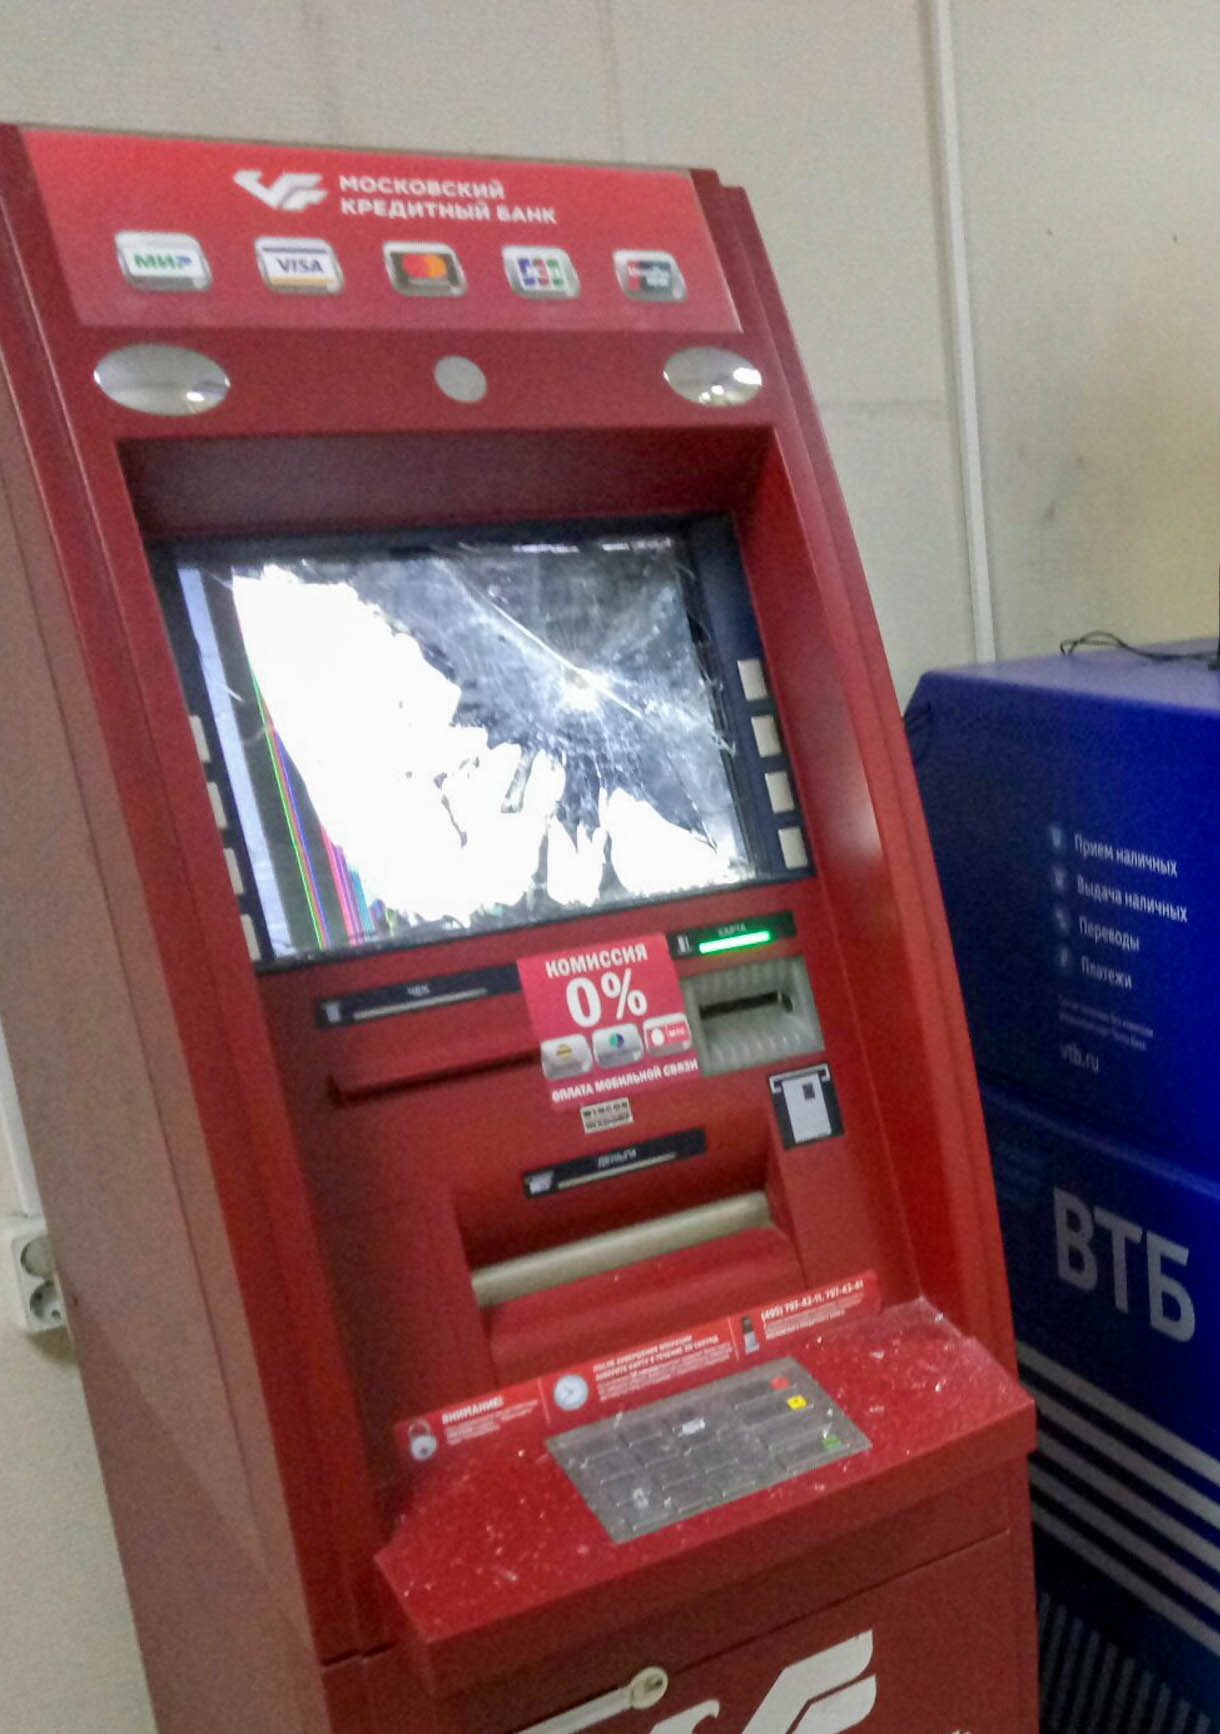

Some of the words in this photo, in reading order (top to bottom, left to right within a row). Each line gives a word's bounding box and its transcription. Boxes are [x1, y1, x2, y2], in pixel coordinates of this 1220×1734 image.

[338, 175, 505, 199] МОСКОВСКИЙ
[340, 197, 491, 221] КРЕДИТНЫЙ
[495, 205, 557, 225] БАНК
[276, 257, 325, 274] VISA
[1115, 847, 1178, 878] наличных
[1077, 873, 1122, 904] Выдача
[1124, 891, 1188, 923] наличных
[1079, 915, 1140, 952] Переводы
[545, 943, 648, 979] КОМИССИЯ
[1081, 955, 1132, 990] Платежи
[566, 968, 648, 1028] 0%
[552, 1083, 593, 1102] ОПЛАТА
[595, 1067, 661, 1093] МОБИЛЬНОЙ
[663, 1058, 698, 1078] СВЯЗИ
[1053, 1186, 1195, 1343] ВТБ
